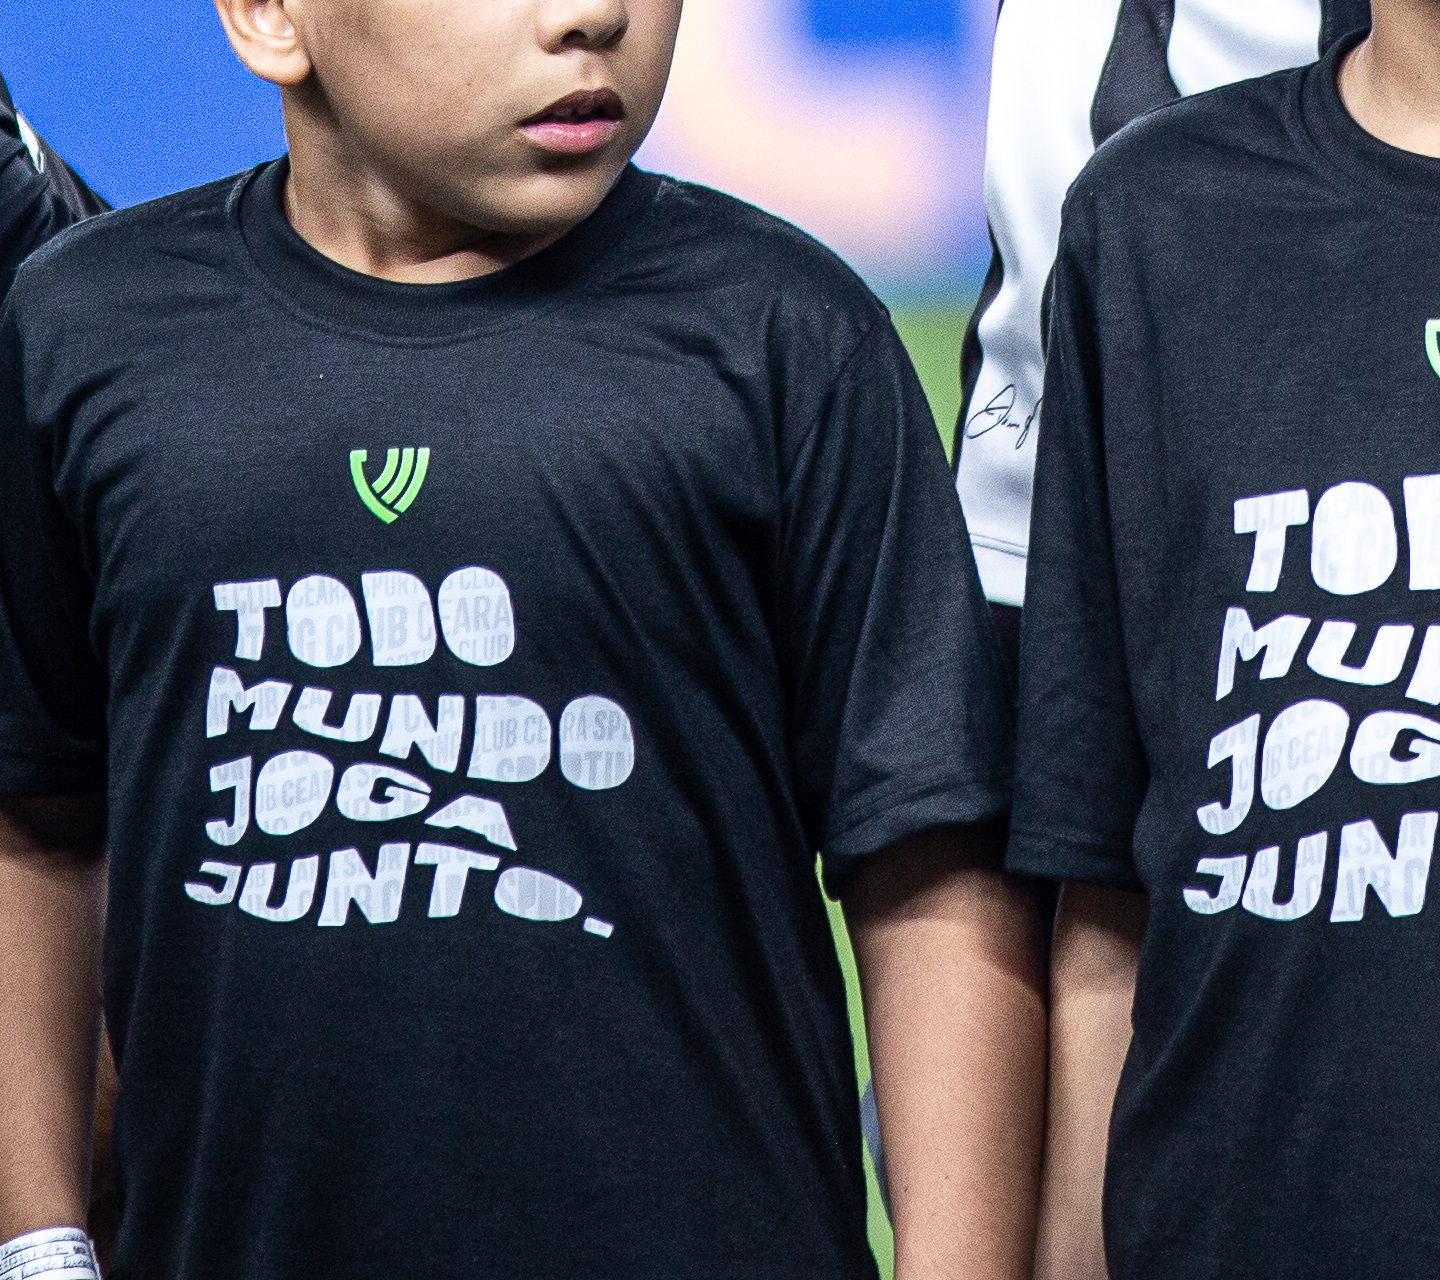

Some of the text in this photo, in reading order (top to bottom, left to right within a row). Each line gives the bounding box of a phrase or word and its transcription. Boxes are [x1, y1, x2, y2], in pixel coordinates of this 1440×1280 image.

[213, 566, 516, 669] TODO
[206, 666, 635, 791] MUNDO
[205, 749, 518, 852] JOGA
[184, 842, 615, 939] JUNTO.
